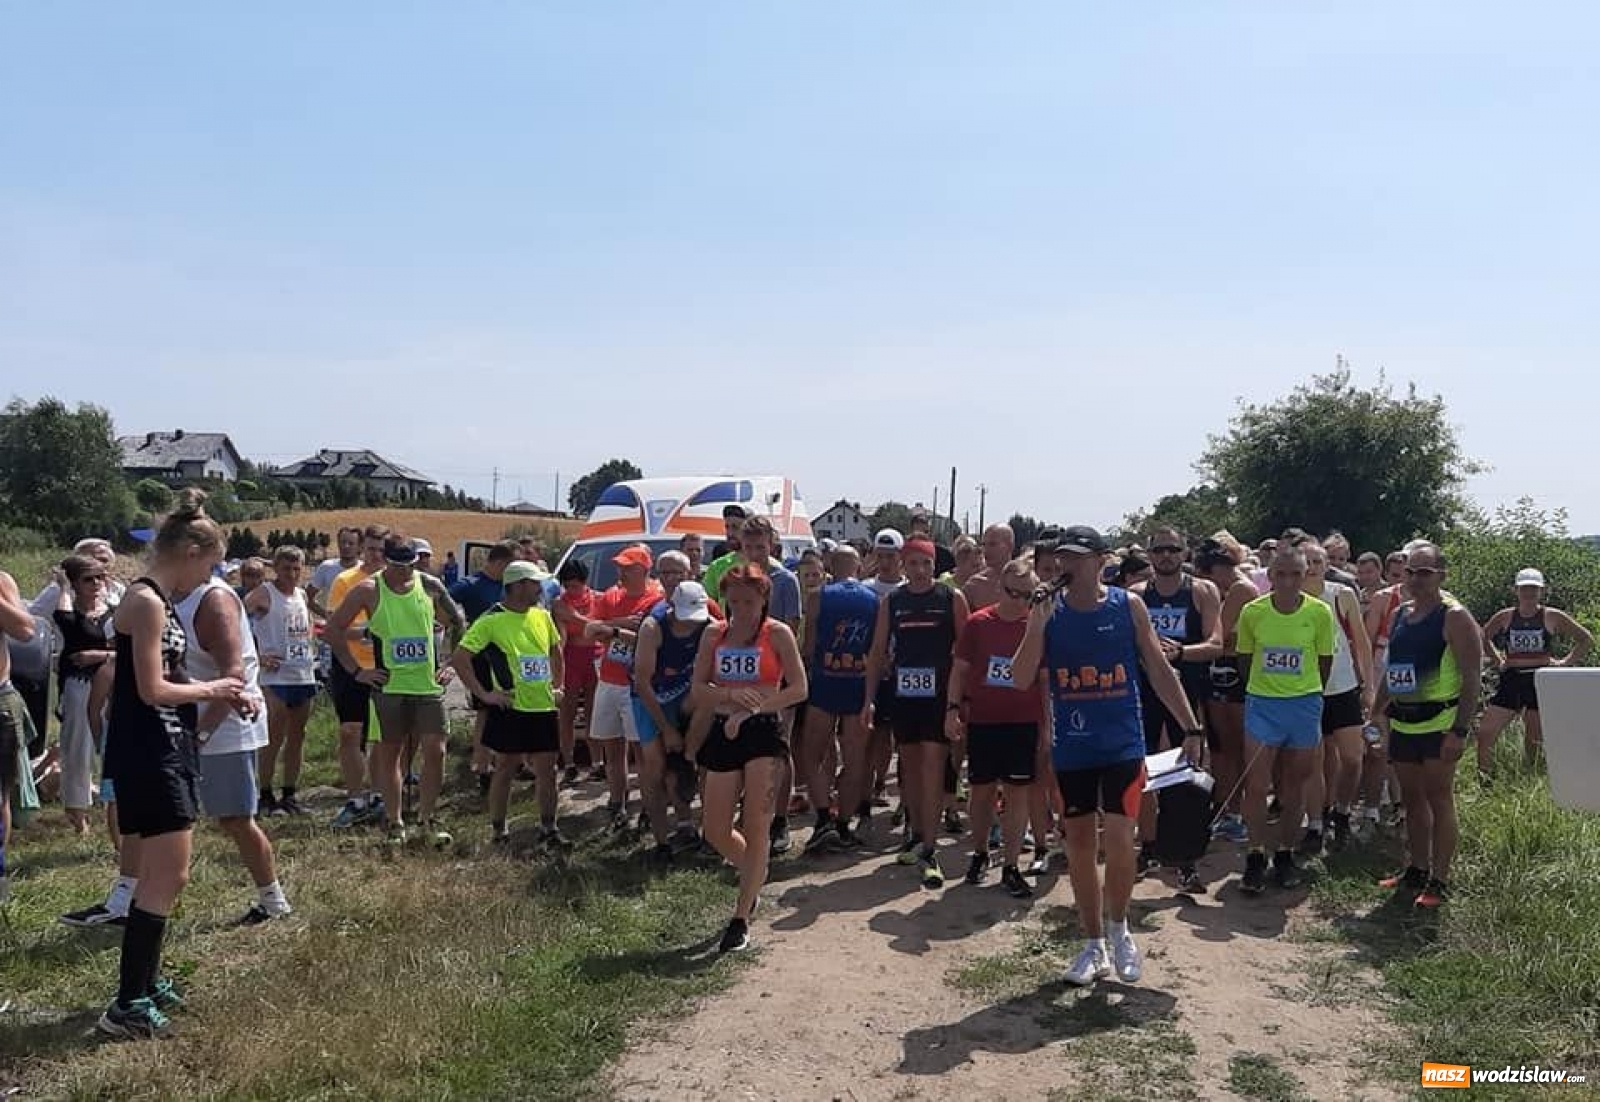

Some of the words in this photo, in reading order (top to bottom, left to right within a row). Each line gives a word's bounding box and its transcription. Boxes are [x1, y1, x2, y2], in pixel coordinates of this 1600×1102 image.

[1150, 613, 1181, 630] 537
[395, 642, 426, 659] 603
[719, 656, 756, 674] 518
[1265, 652, 1299, 670] 540
[990, 662, 1013, 681] 53
[1388, 670, 1413, 687] 544
[901, 674, 932, 690] 538
